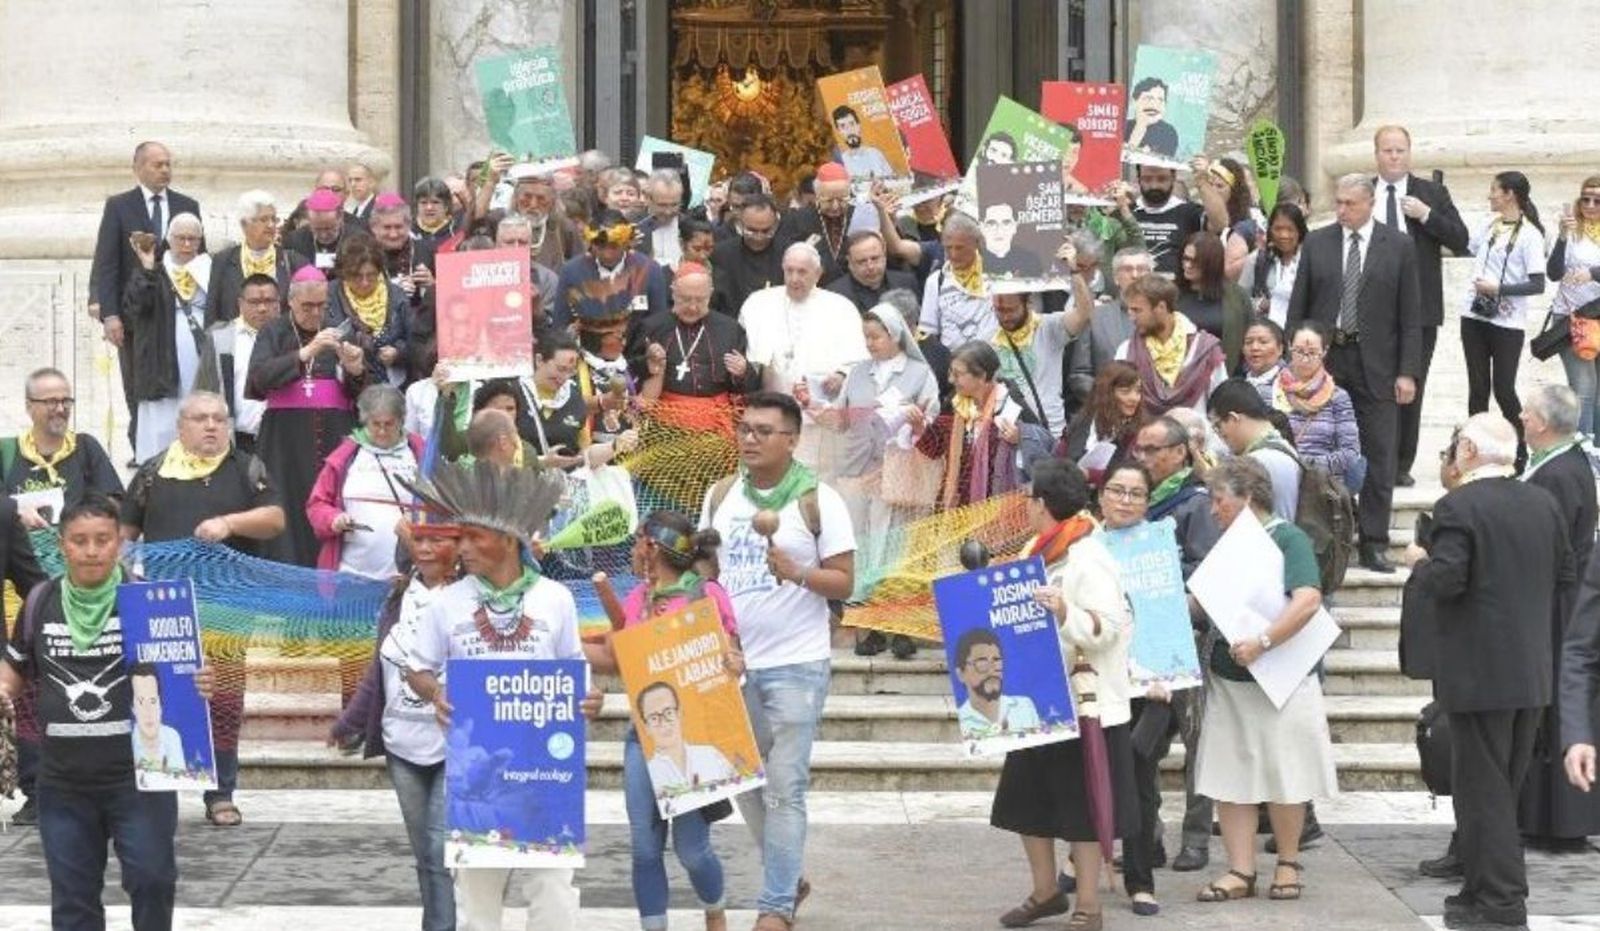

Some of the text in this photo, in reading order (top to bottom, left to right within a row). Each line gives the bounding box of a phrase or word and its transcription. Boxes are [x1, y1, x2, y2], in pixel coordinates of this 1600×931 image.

[149, 616, 192, 639] RODOLFO
[989, 601, 1046, 629] MORAES
[648, 632, 720, 675] ALEJANDRO
[485, 668, 575, 699] ecología
[494, 695, 575, 729] integral
